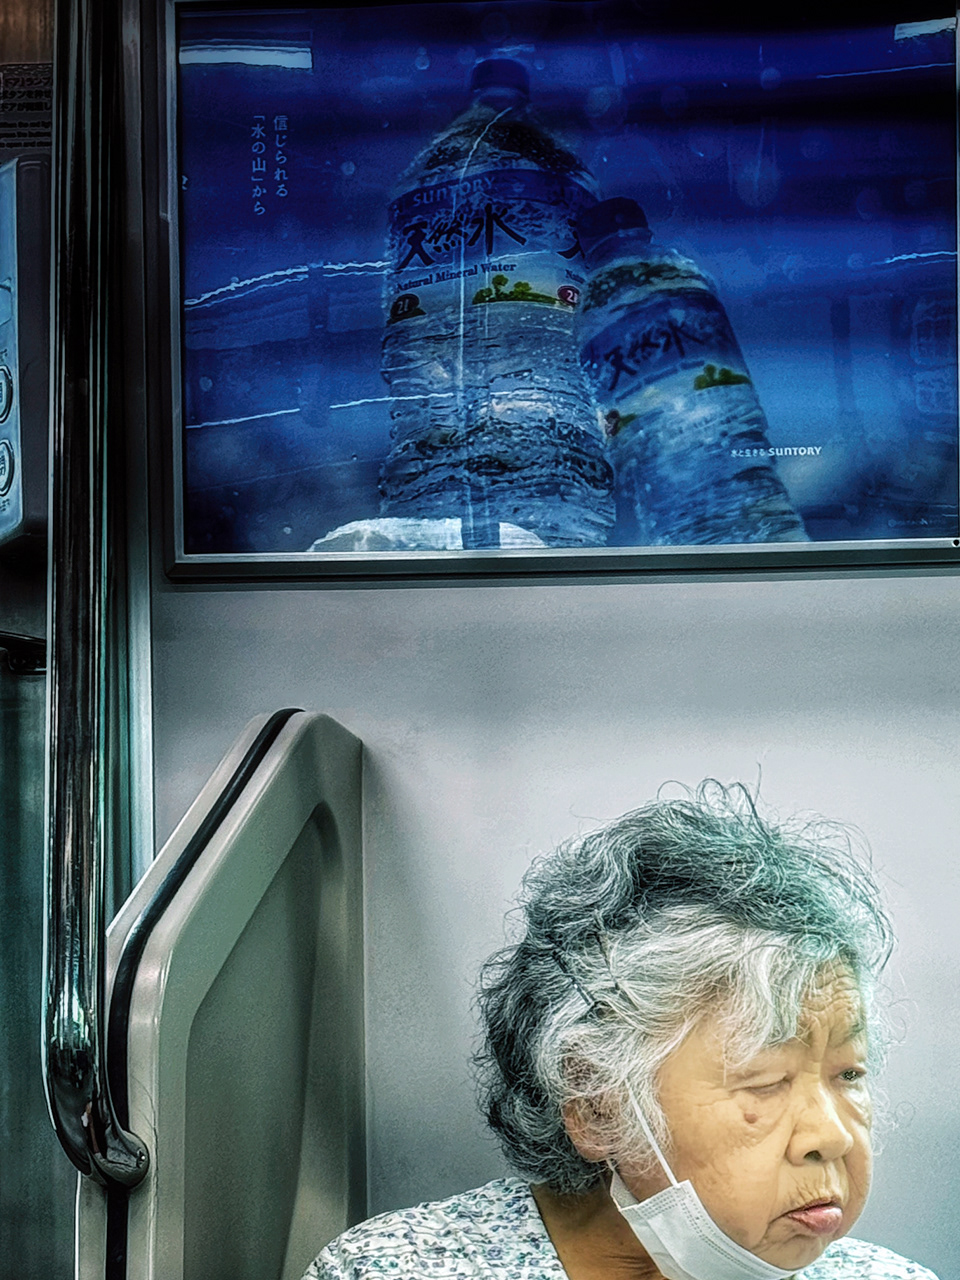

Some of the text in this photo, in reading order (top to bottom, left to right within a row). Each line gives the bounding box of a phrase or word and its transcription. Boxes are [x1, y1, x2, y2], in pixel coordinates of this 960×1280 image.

[250, 115, 267, 216] 「水の山」から
[273, 115, 288, 197] 信じられる
[412, 176, 496, 207] SUNTORY
[390, 202, 527, 274] 天然水
[767, 446, 822, 457] SUNTORY
